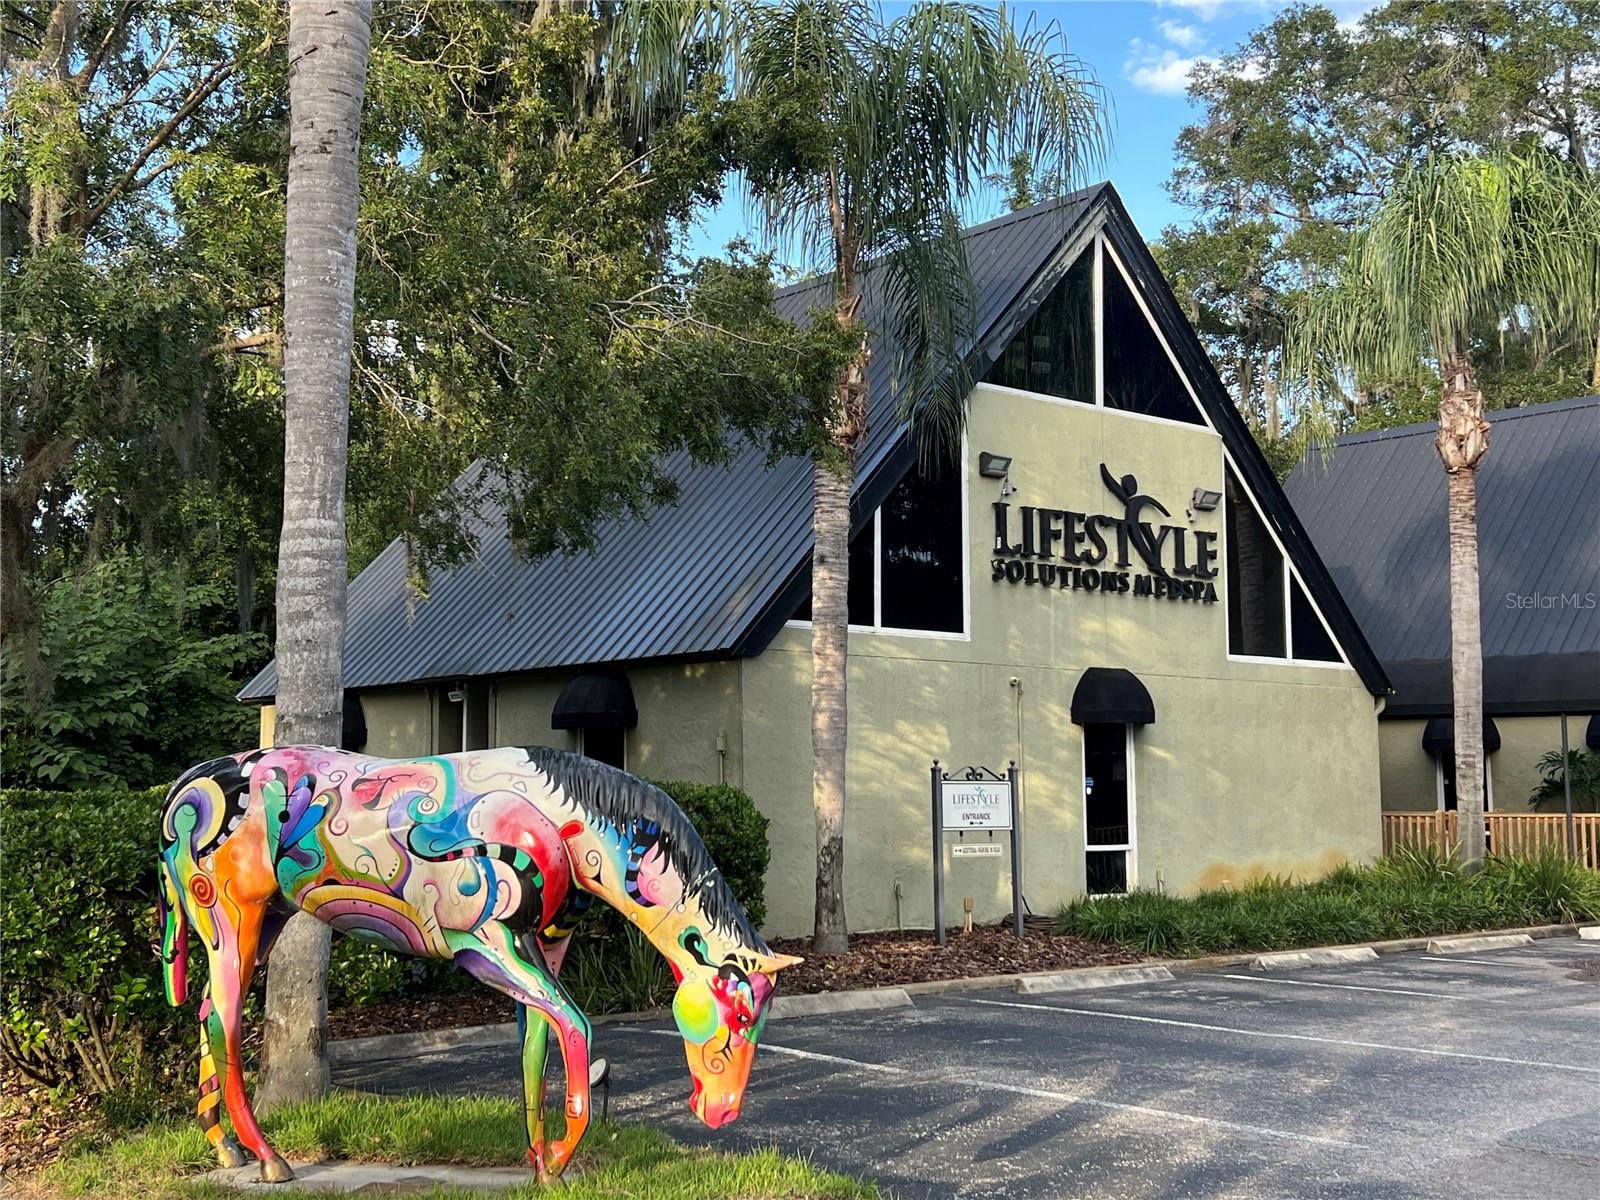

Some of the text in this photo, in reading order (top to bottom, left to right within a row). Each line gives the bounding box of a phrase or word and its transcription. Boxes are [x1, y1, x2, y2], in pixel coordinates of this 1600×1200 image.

[992, 502, 1219, 578] LIFESTYLE
[991, 558, 1220, 604] SOLUTIONS MEDSPA
[952, 793, 1000, 805] LIFESTYLE
[962, 812, 991, 821] ENTRANCE
